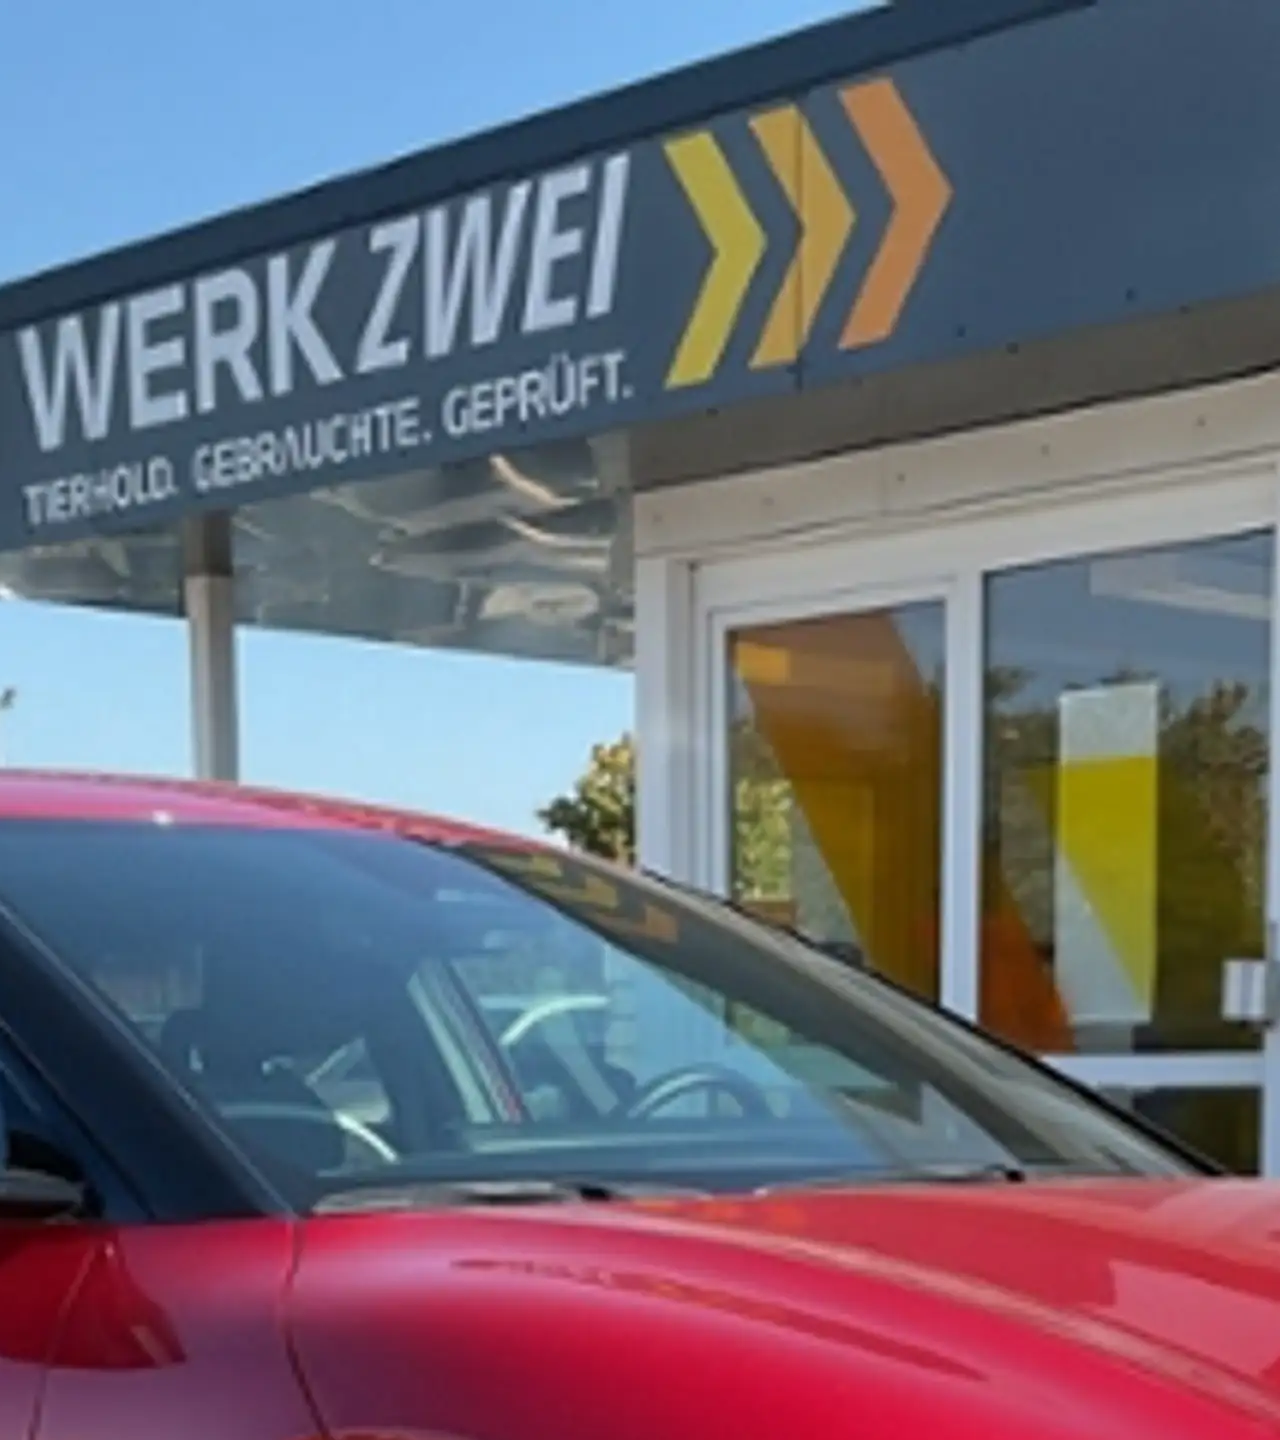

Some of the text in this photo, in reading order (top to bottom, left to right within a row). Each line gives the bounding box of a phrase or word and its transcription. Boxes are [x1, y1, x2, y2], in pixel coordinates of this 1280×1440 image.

[19, 152, 631, 451] WERK ZWEI
[441, 349, 634, 438] GEPRÜFT.
